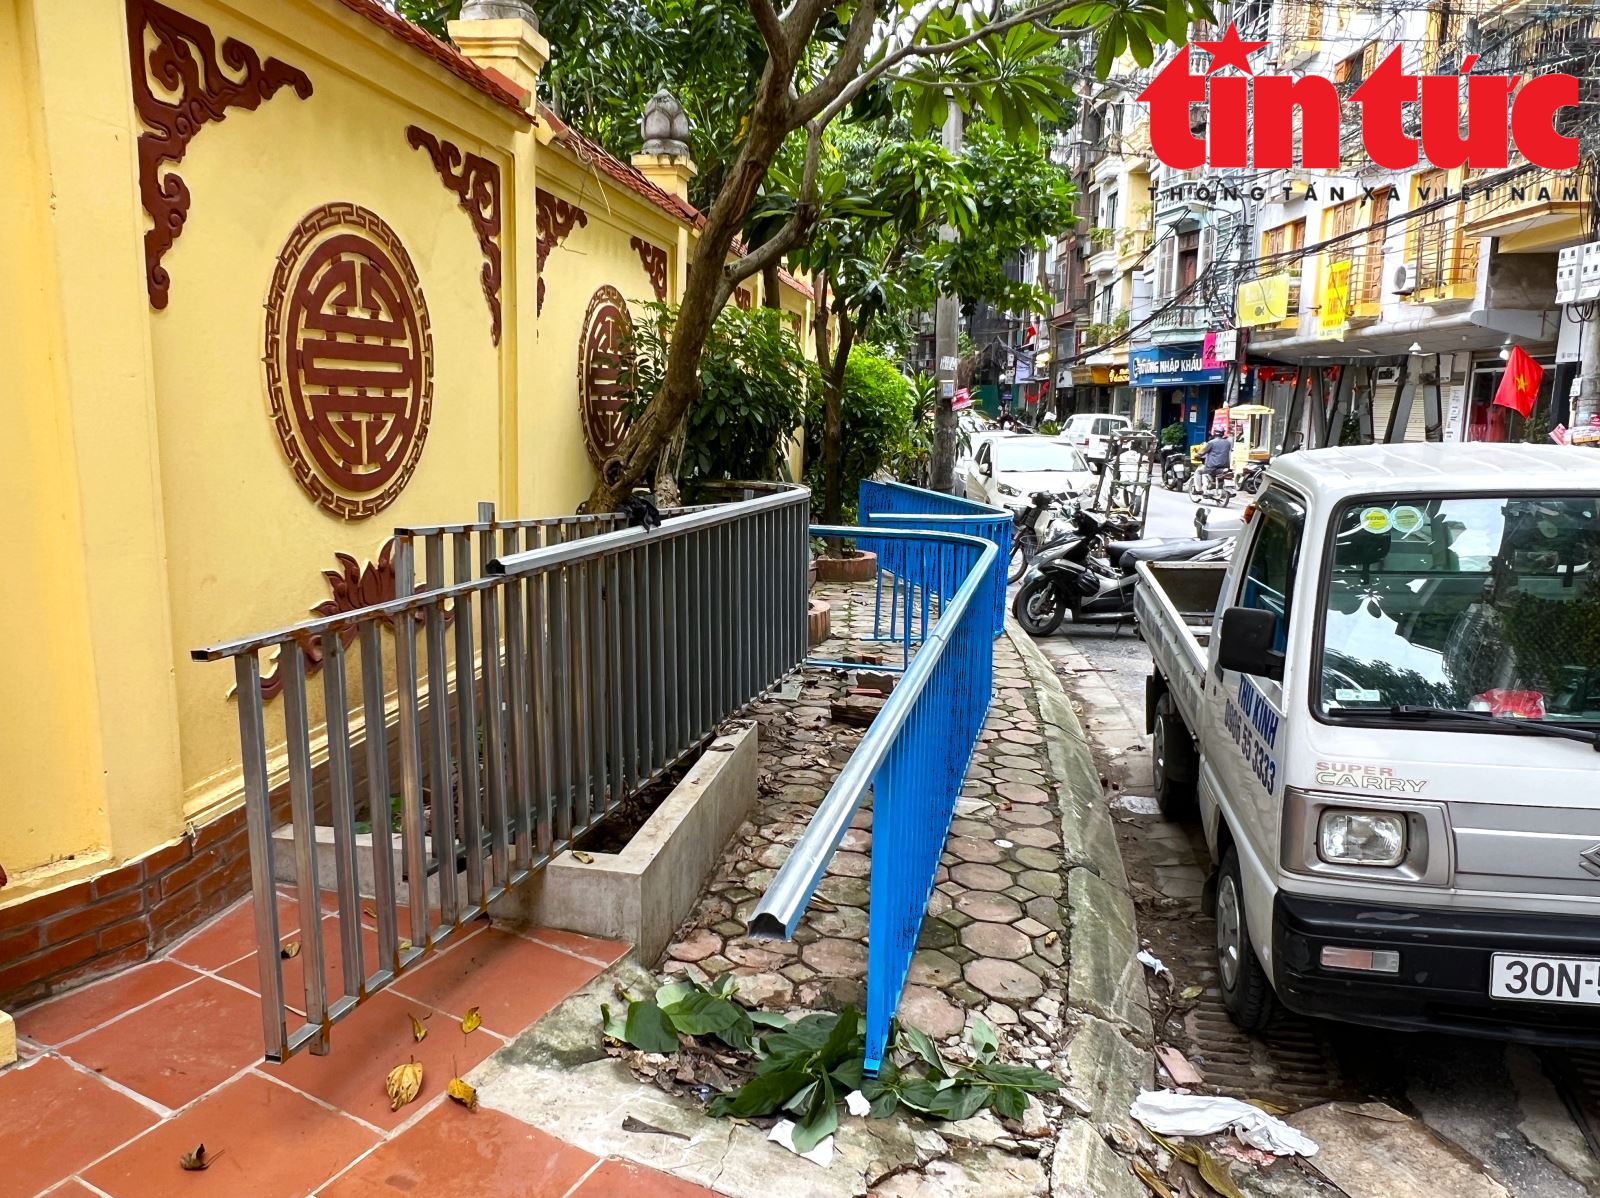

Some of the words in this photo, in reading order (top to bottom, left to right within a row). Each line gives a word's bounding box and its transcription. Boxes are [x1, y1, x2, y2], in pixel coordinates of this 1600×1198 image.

[1160, 357, 1180, 375] NHẬP
[1181, 353, 1203, 372] KHẨU
[1252, 740, 1276, 796] 3333
[1315, 761, 1394, 777] SUPER
[1315, 772, 1428, 793] CARRY
[1504, 959, 1600, 998] 30N-
